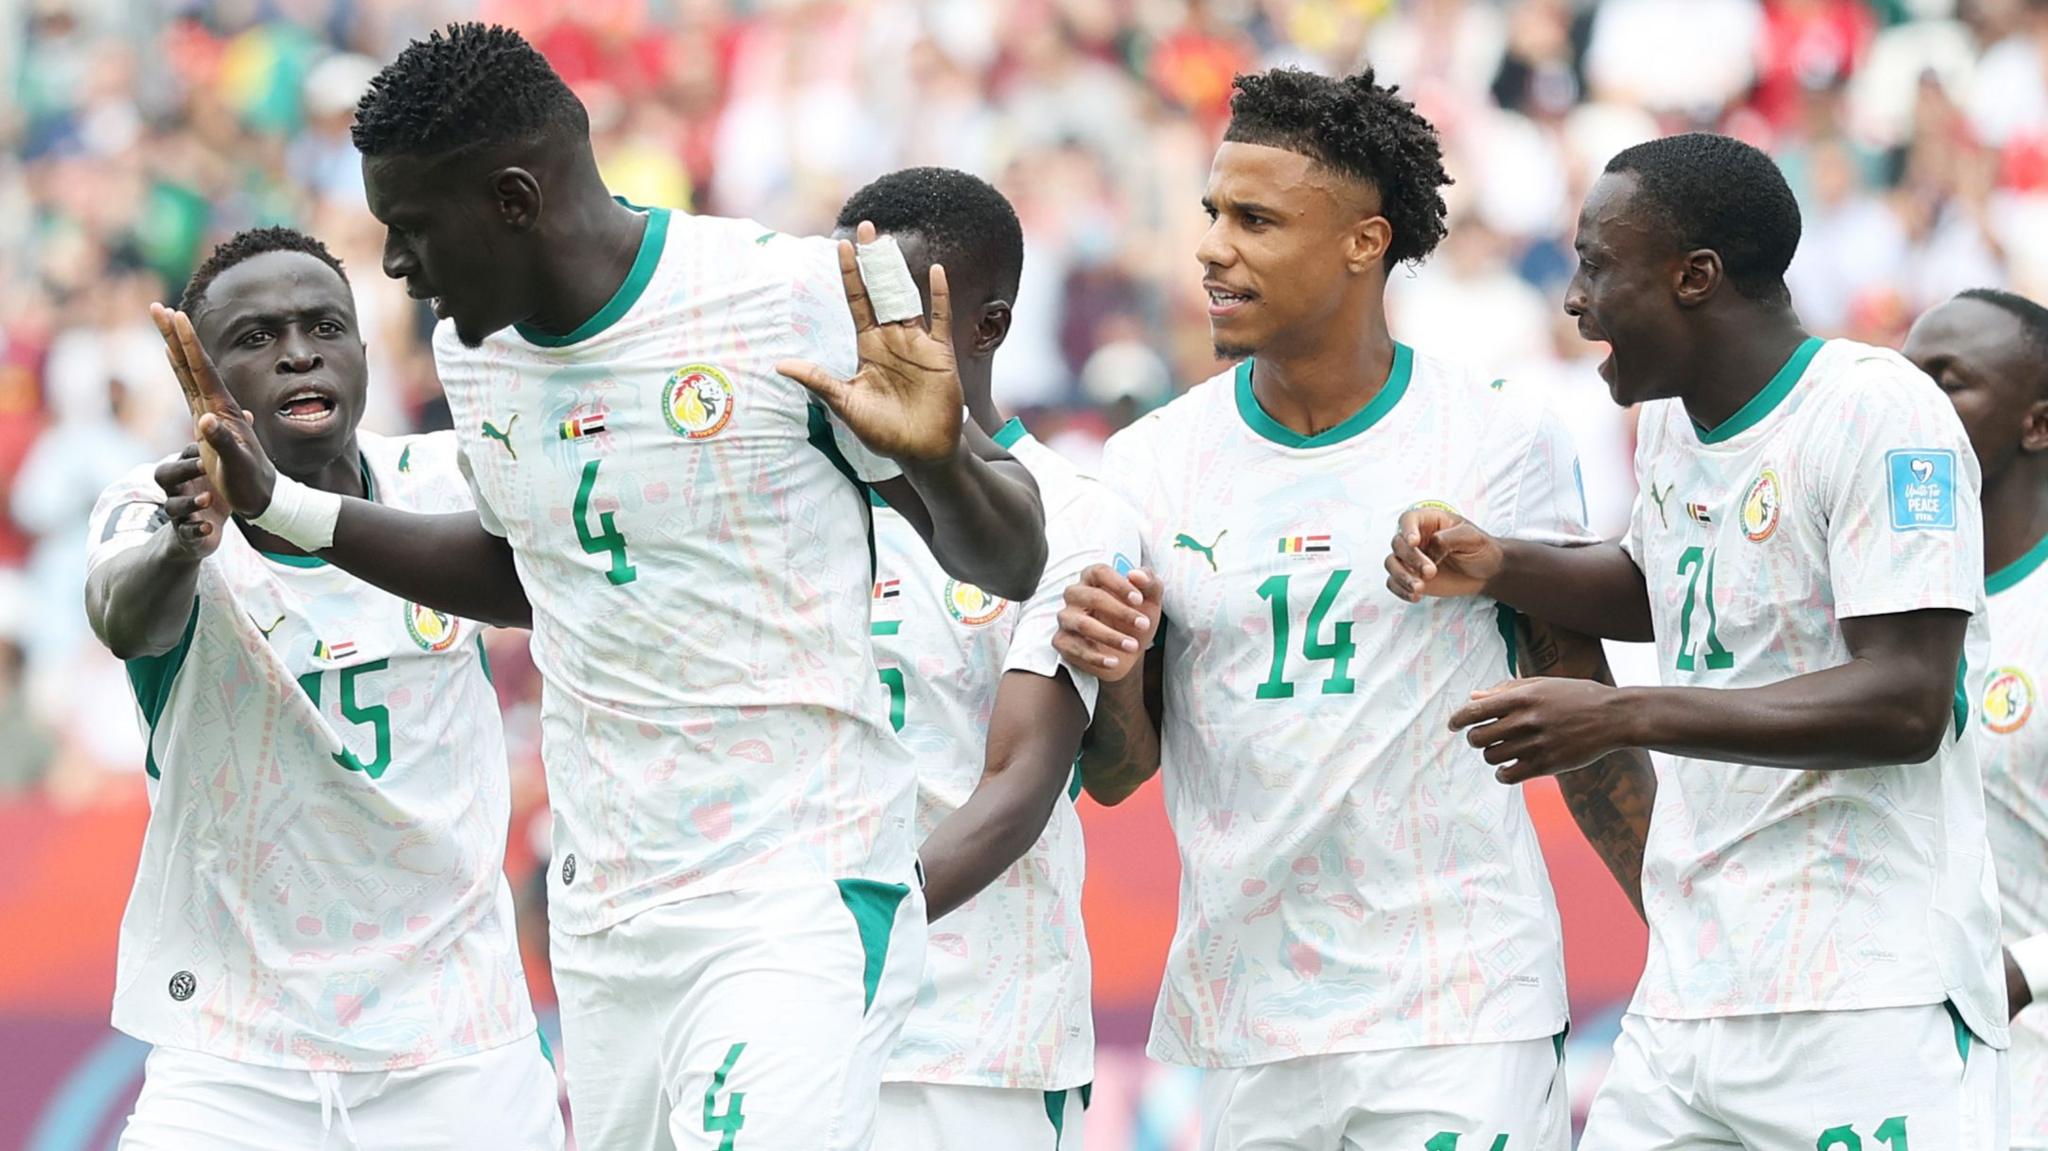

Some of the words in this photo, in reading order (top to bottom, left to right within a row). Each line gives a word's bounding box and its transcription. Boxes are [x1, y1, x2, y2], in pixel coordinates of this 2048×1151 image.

[573, 459, 637, 586] 4
[1908, 498, 1940, 512] PEACE
[1256, 569, 1354, 700] 14
[1676, 546, 1734, 672] 21
[703, 1042, 748, 1151] 4
